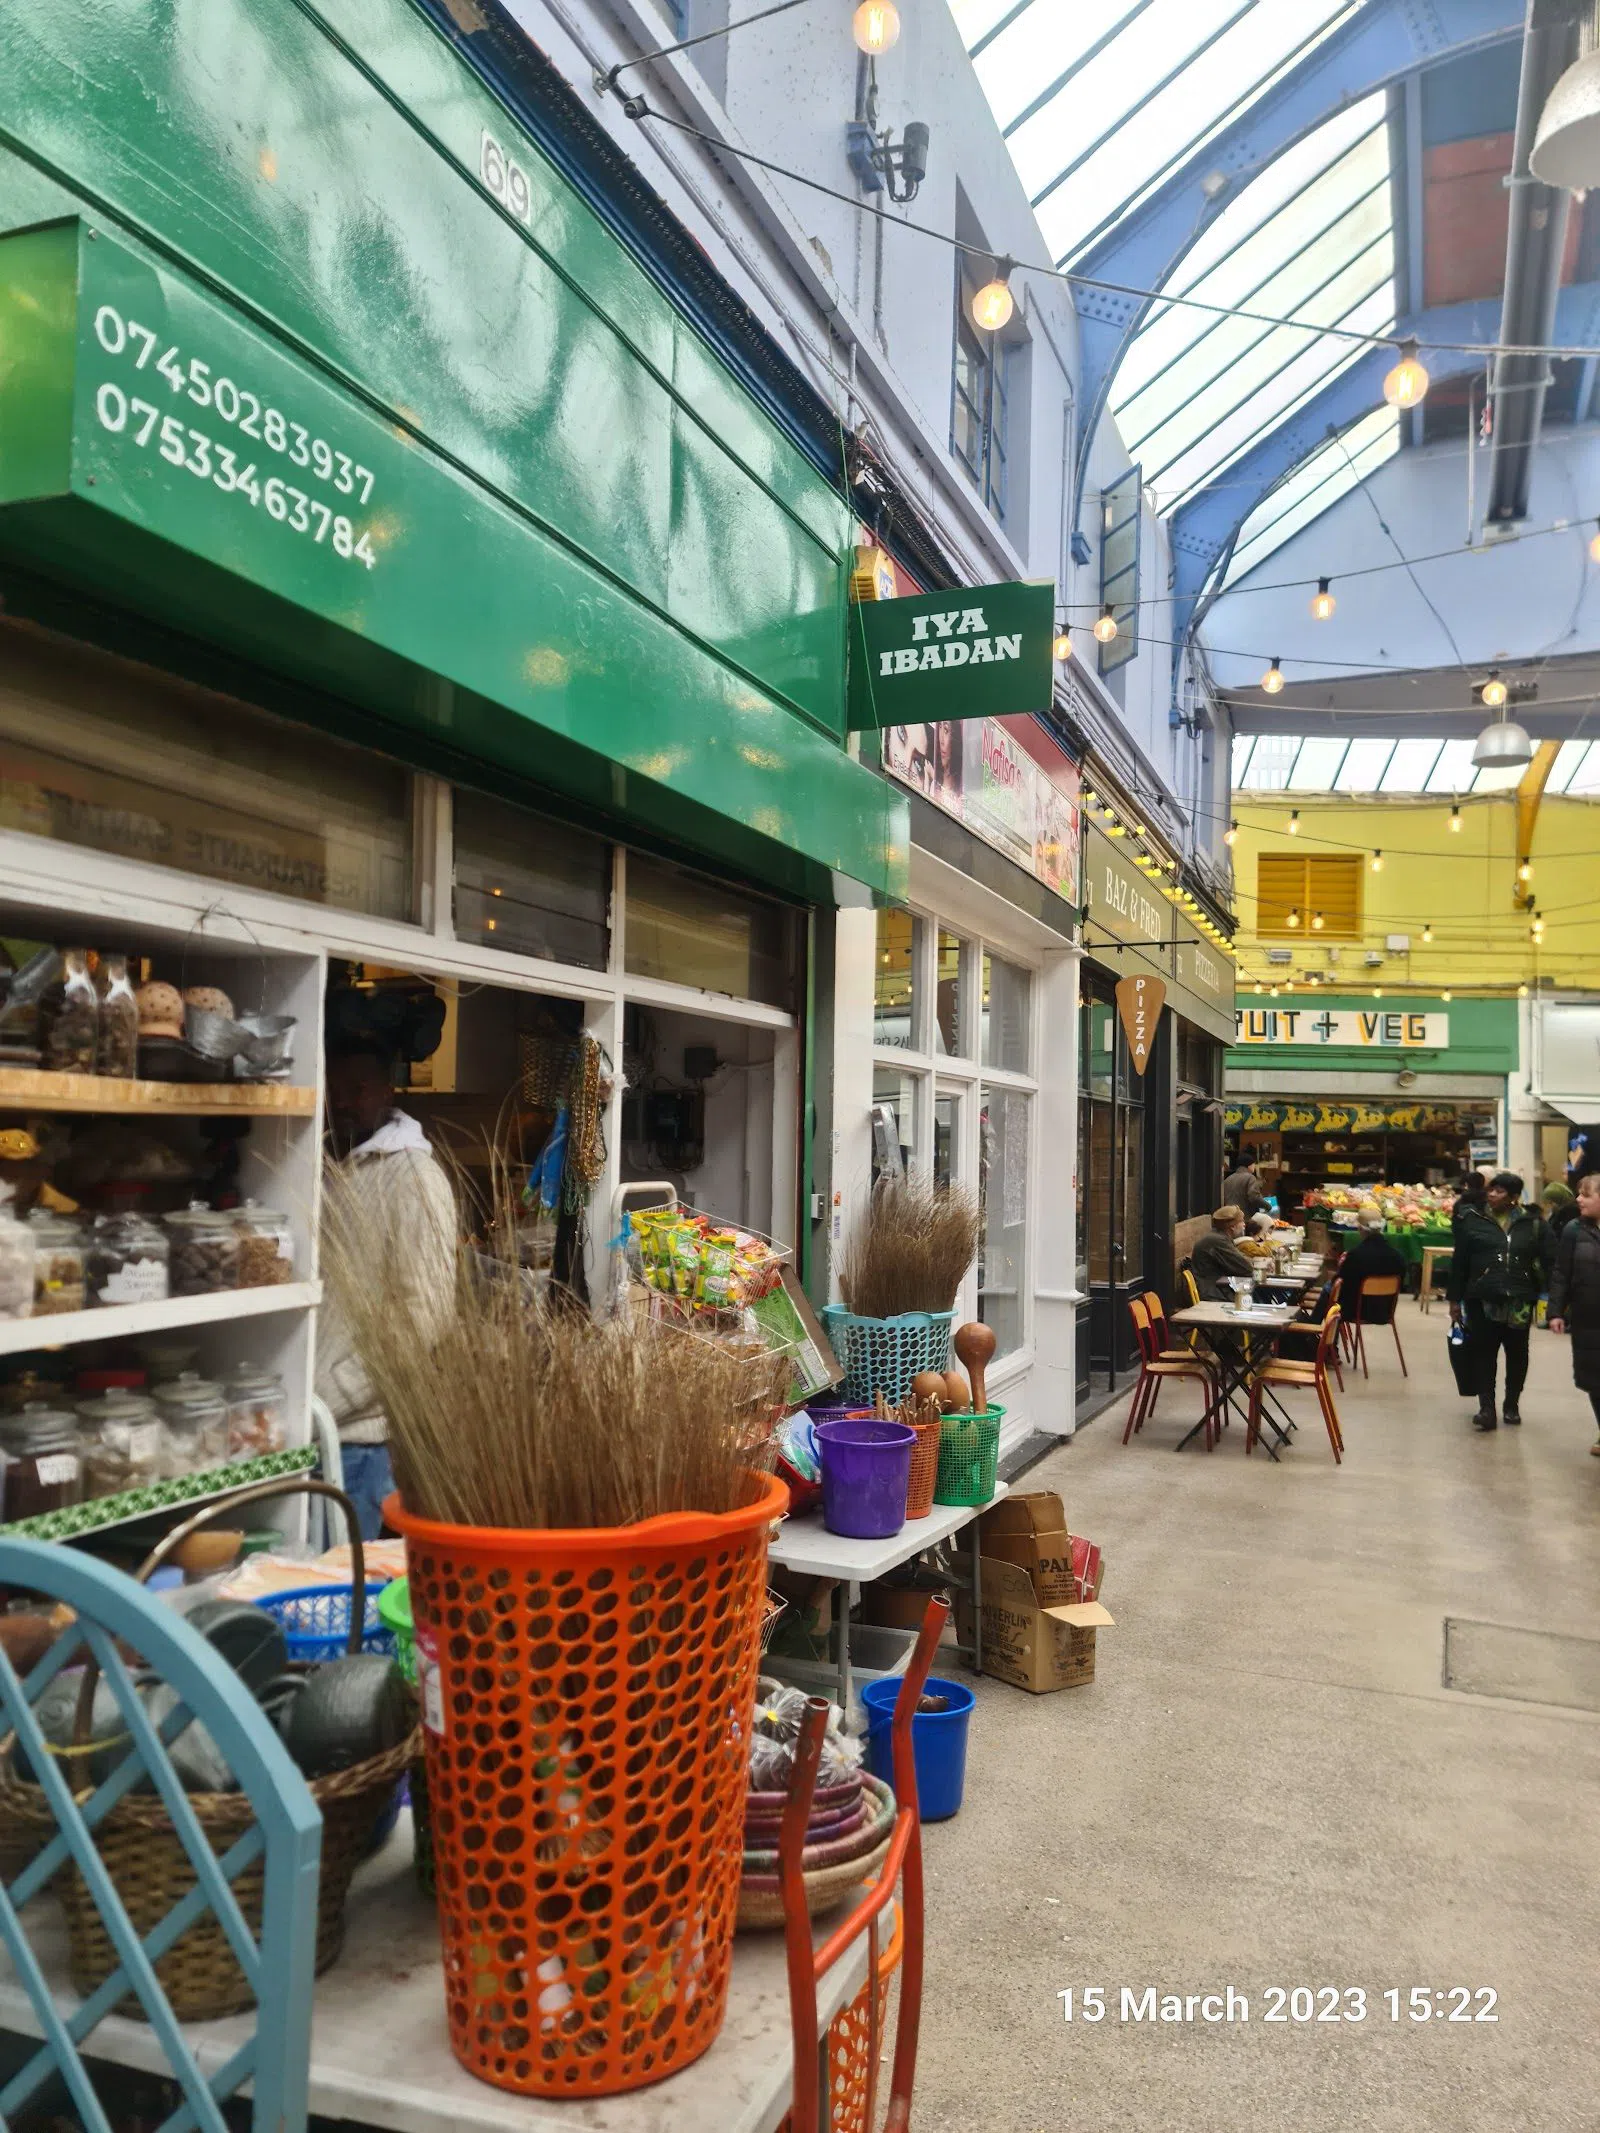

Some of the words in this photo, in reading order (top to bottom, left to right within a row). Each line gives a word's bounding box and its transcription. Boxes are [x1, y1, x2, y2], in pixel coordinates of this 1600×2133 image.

[484, 139, 529, 219] 69
[94, 305, 375, 505] 07450283937
[96, 383, 376, 569] 07533463784
[880, 633, 1022, 676] IBADAN
[912, 607, 988, 641] IYA
[1105, 866, 1127, 916] BAZ
[1130, 887, 1138, 923] &
[1140, 896, 1161, 943] FRED
[1135, 979, 1146, 1056] PIZZA
[1357, 1012, 1426, 1044] VEG
